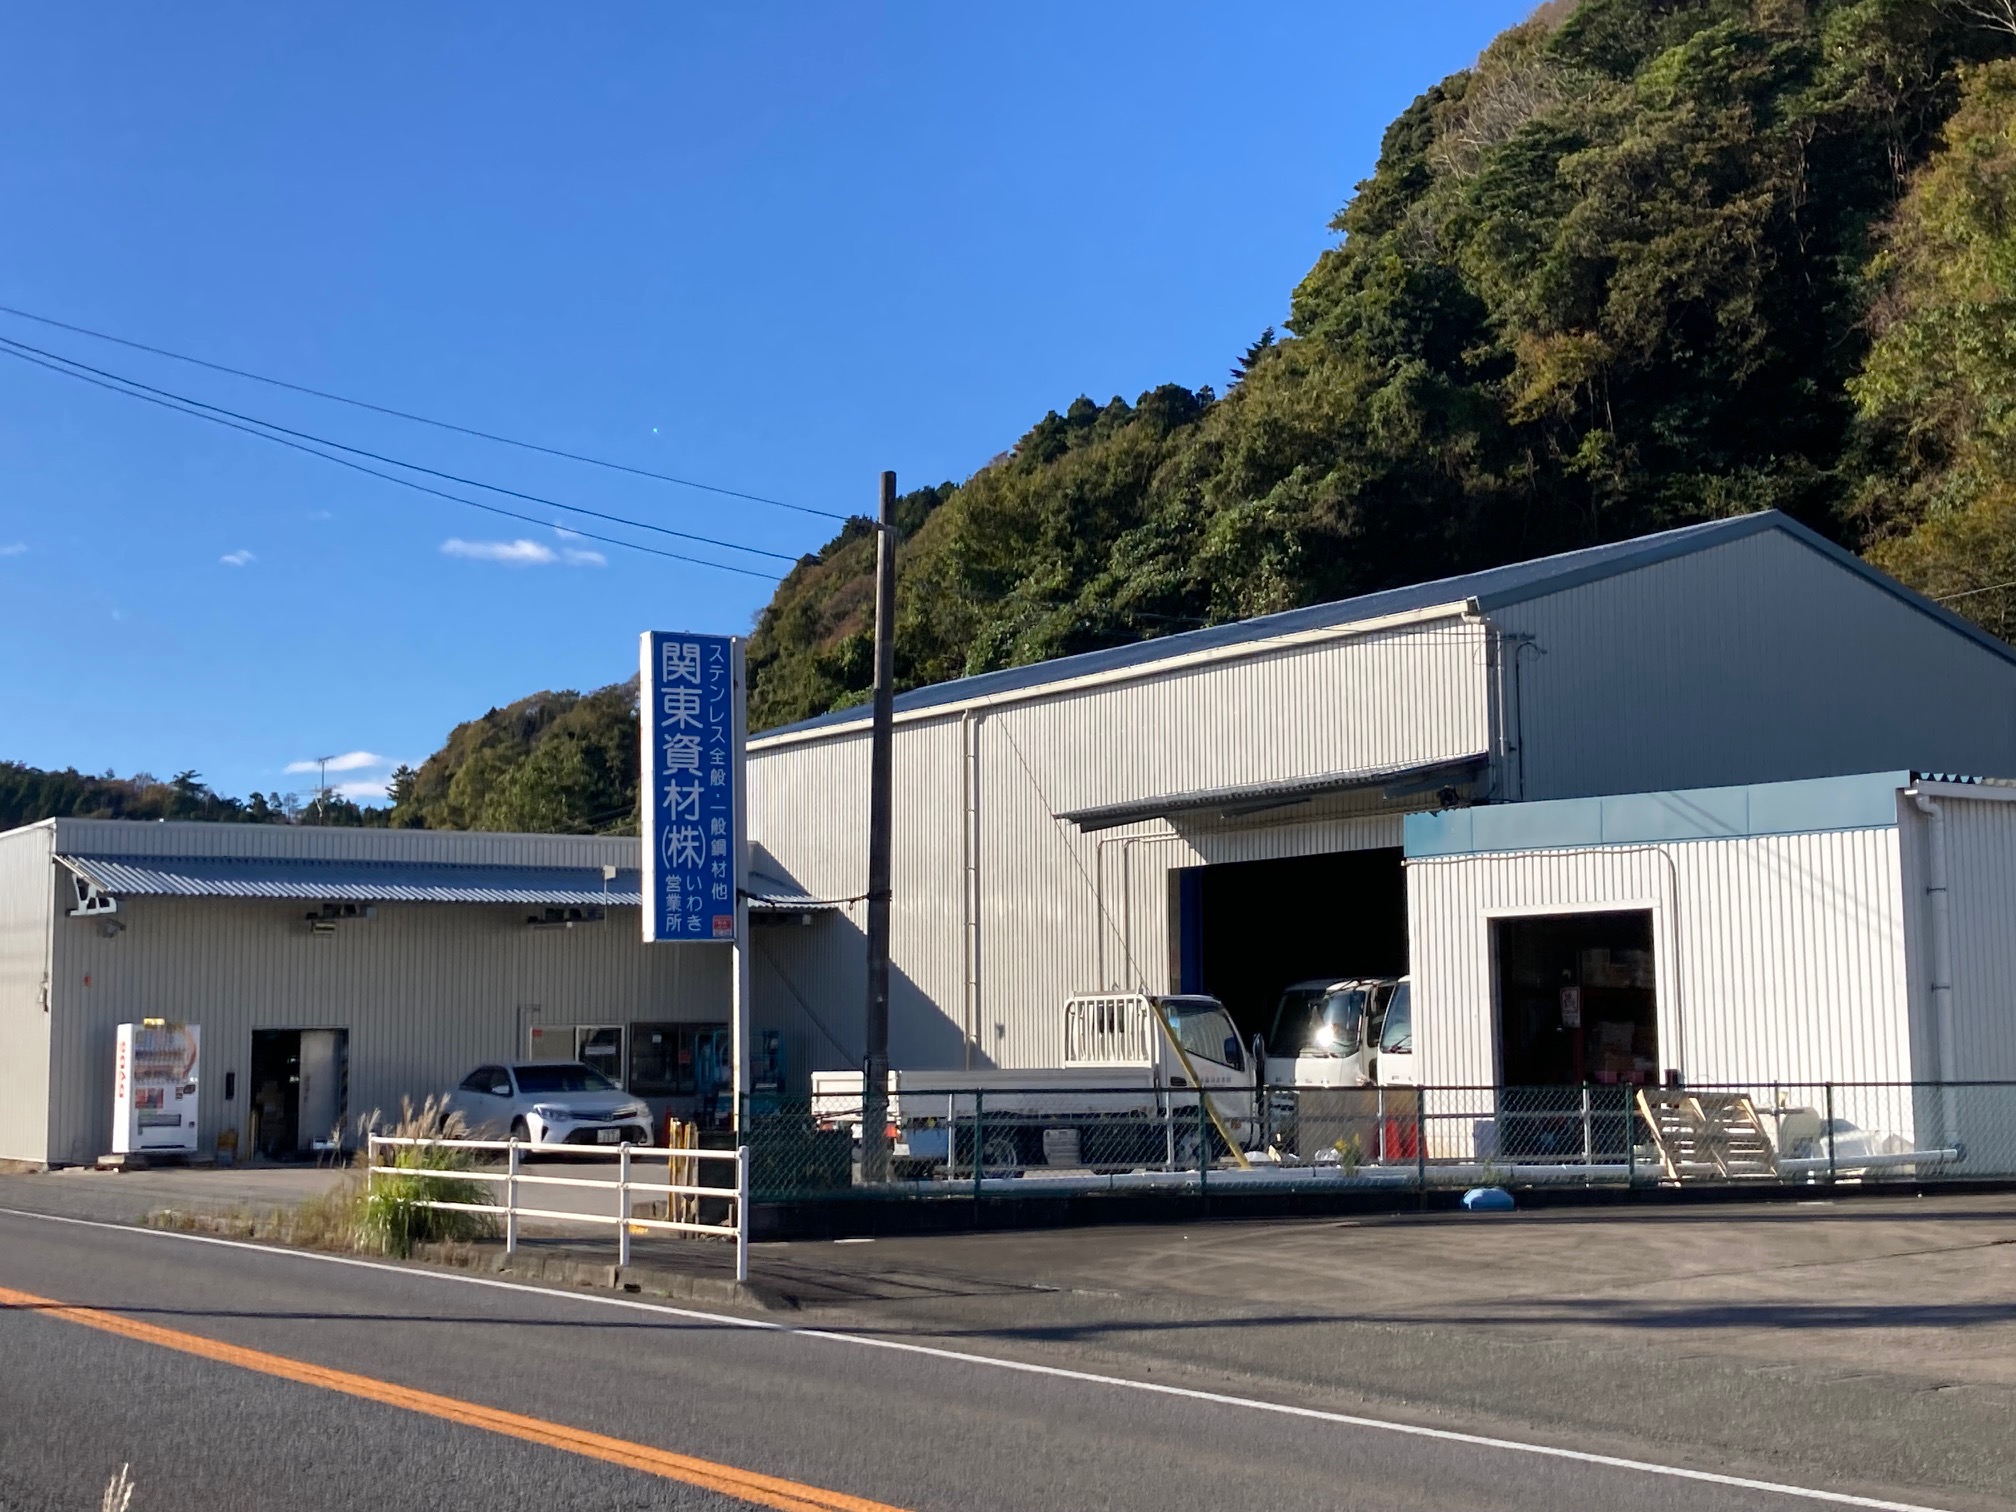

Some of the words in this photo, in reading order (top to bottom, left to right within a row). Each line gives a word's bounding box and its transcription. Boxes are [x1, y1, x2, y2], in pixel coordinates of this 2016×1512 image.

[661, 641, 706, 870] 関東資材(株)
[665, 873, 683, 933] 営業所
[686, 874, 703, 932] いわき
